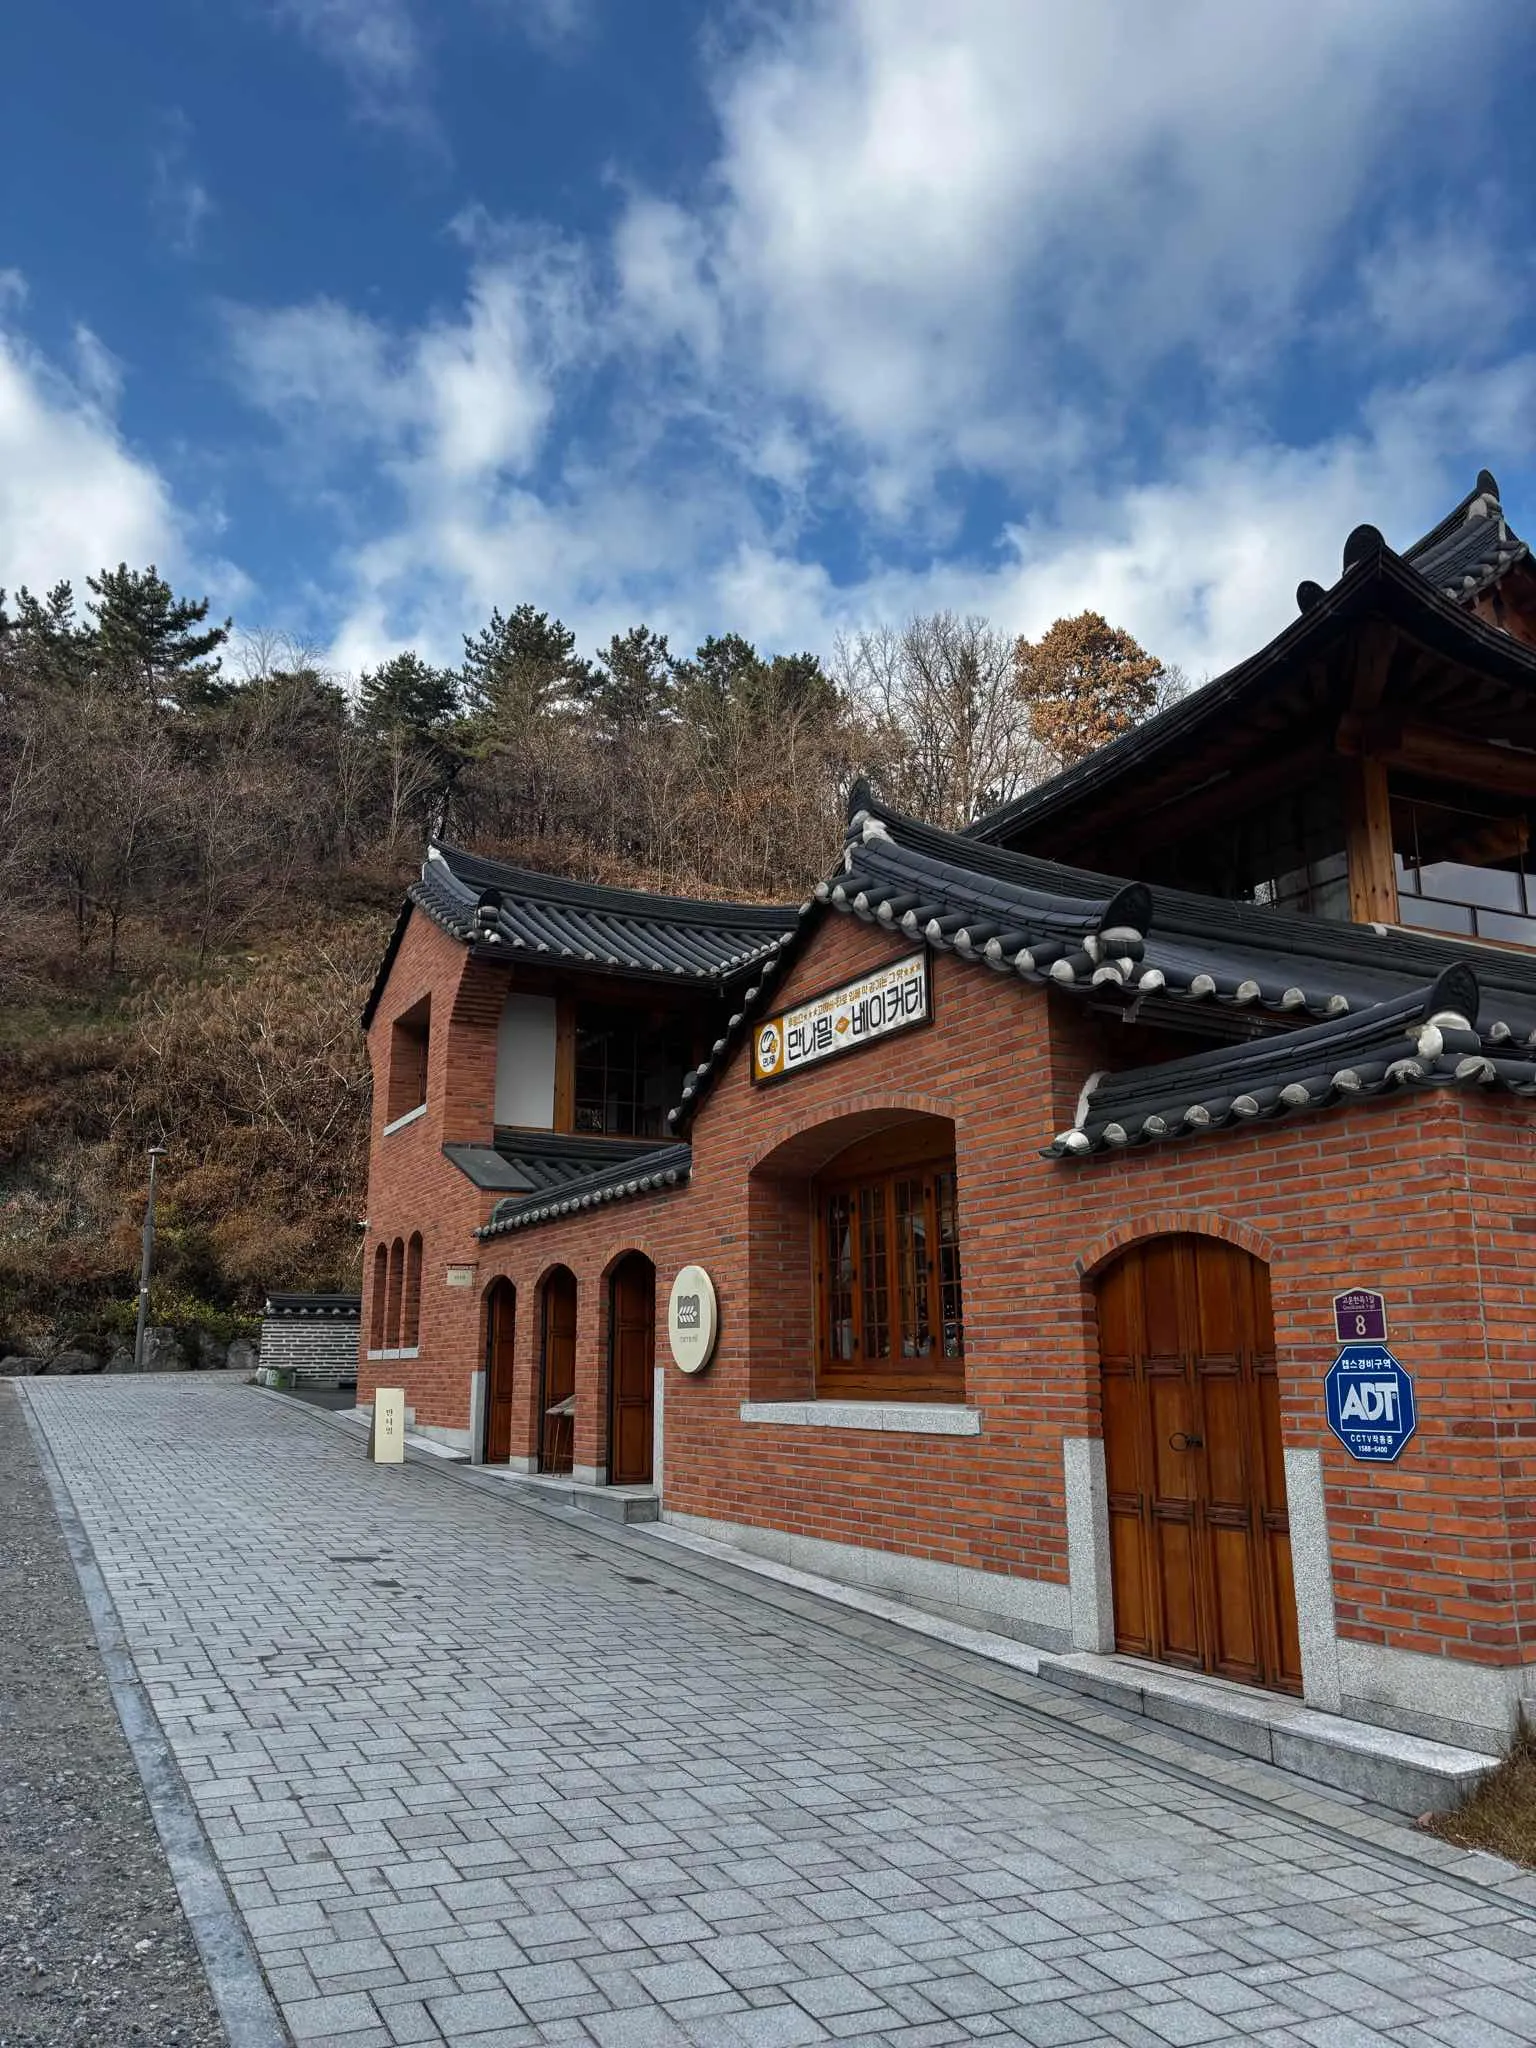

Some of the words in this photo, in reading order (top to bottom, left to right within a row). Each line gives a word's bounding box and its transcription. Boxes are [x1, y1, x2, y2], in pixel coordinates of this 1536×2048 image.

[788, 1014, 833, 1061] 만나밀
[852, 976, 923, 1035] 베이커리
[1355, 1314, 1366, 1335] 8
[1341, 1359, 1392, 1370] 캡스경비구역
[1341, 1382, 1398, 1421] ADT
